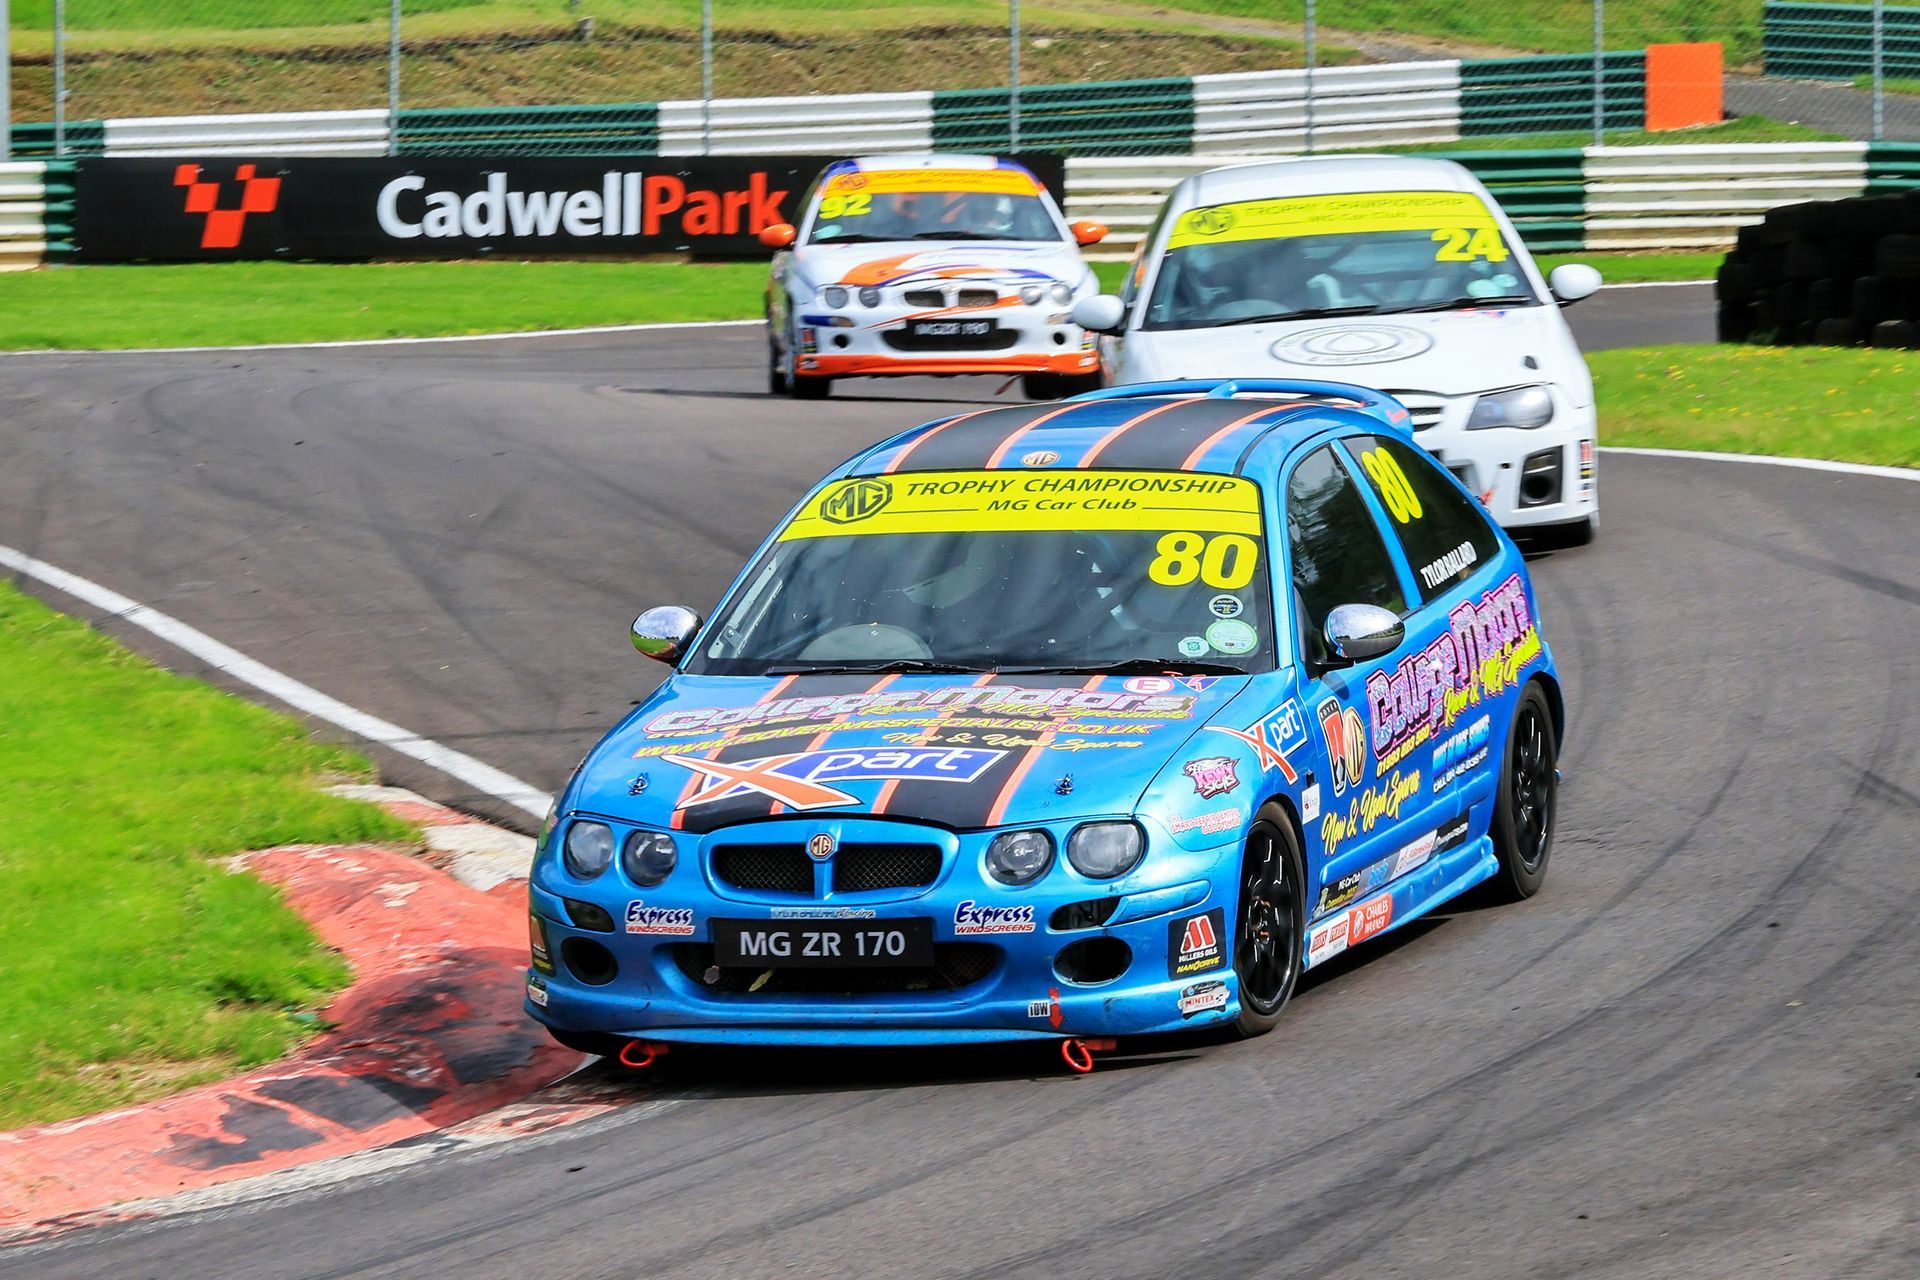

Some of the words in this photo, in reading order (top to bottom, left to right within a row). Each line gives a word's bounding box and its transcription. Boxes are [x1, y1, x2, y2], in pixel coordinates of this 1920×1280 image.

[819, 193, 872, 219] 92
[1431, 228, 1509, 262] 24
[907, 479, 1015, 497] TROPHY
[1023, 478, 1237, 495] CHAMPIONSHIP
[1361, 447, 1423, 523] 80
[987, 500, 1028, 510] MG
[1036, 499, 1078, 510] Car
[1083, 498, 1138, 510] Club
[1148, 532, 1258, 590] 80
[946, 732, 975, 744] &
[1347, 798, 1360, 839] &
[811, 835, 834, 857] MG
[627, 901, 692, 927] Express
[956, 901, 1032, 928] Express
[627, 925, 694, 934] WINDSCREENS
[956, 923, 1034, 933] WINDSCREENS
[740, 932, 791, 956] MG
[802, 932, 841, 957] ZR
[854, 931, 906, 956] 170
[1185, 994, 1215, 1007] MINTEX
